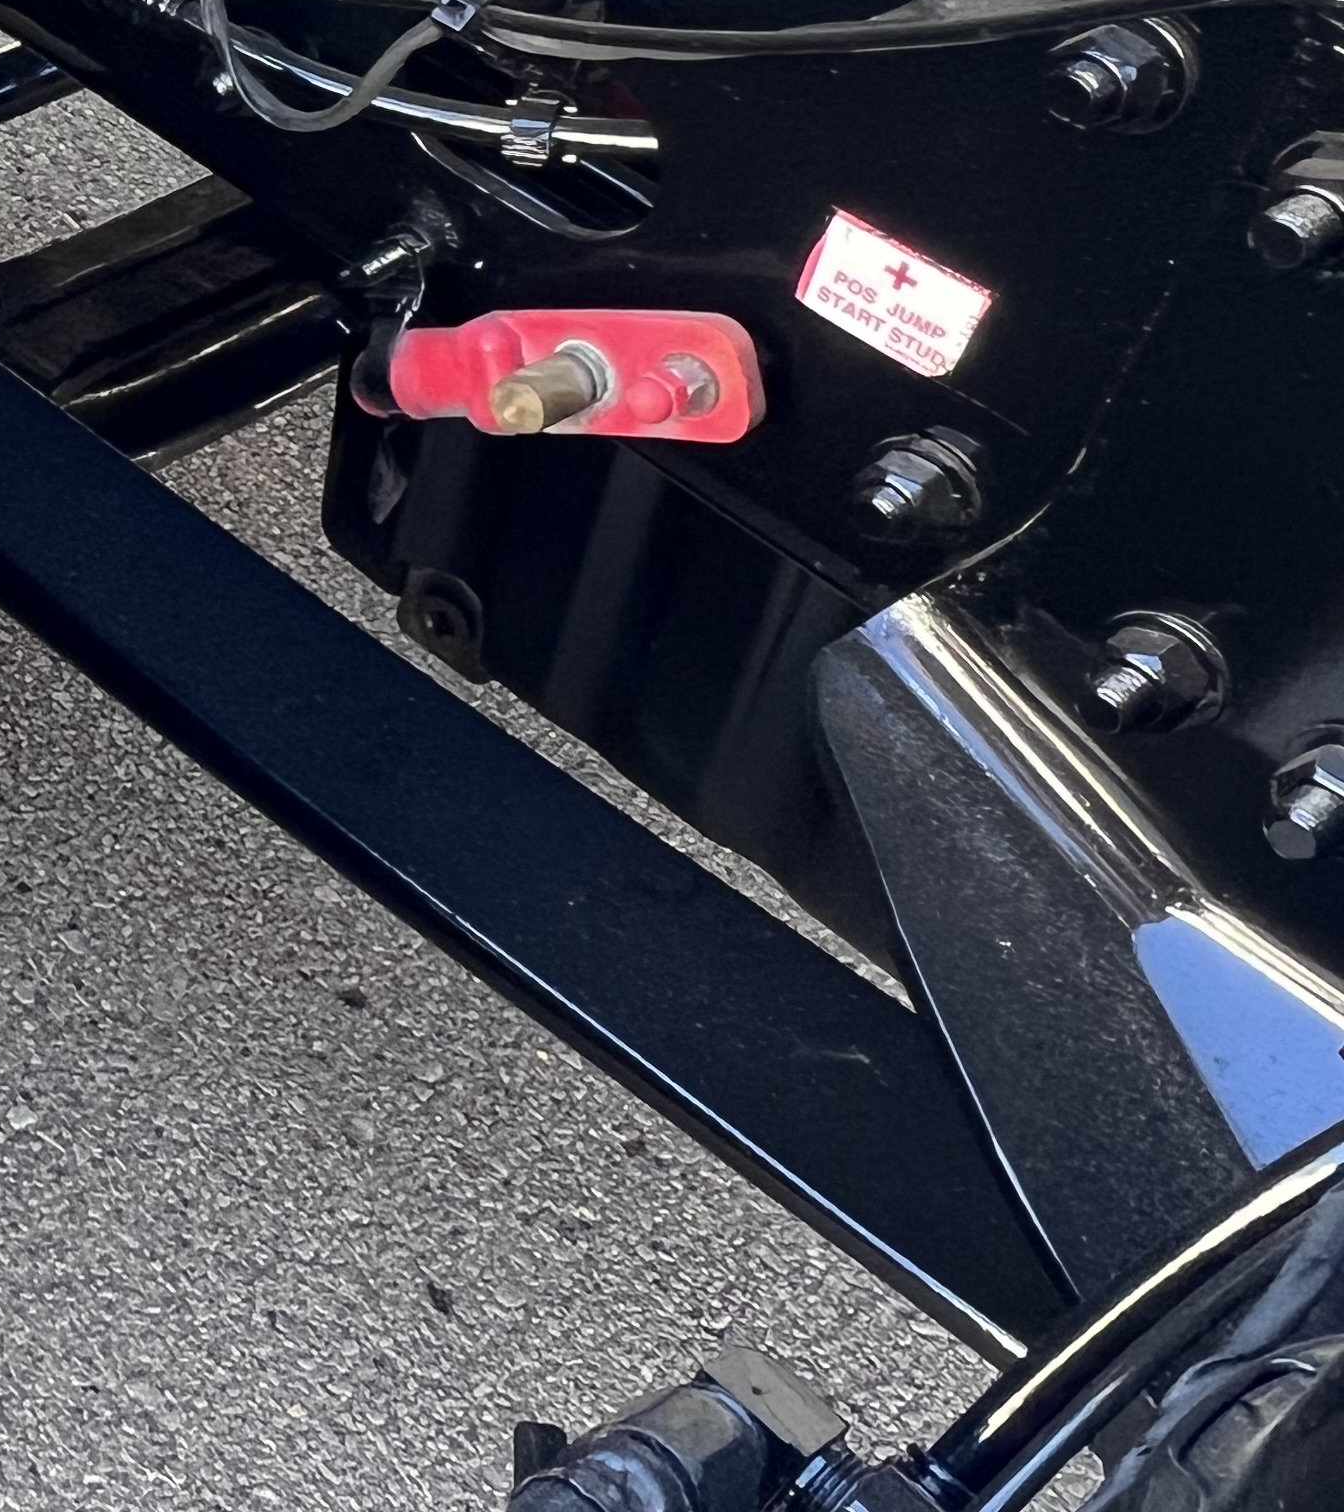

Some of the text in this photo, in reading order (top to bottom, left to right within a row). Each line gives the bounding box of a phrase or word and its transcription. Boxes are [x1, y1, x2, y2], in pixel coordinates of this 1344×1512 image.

[817, 285, 887, 333] START
[888, 326, 946, 366] STUD
[833, 270, 946, 338] POS JUMP
